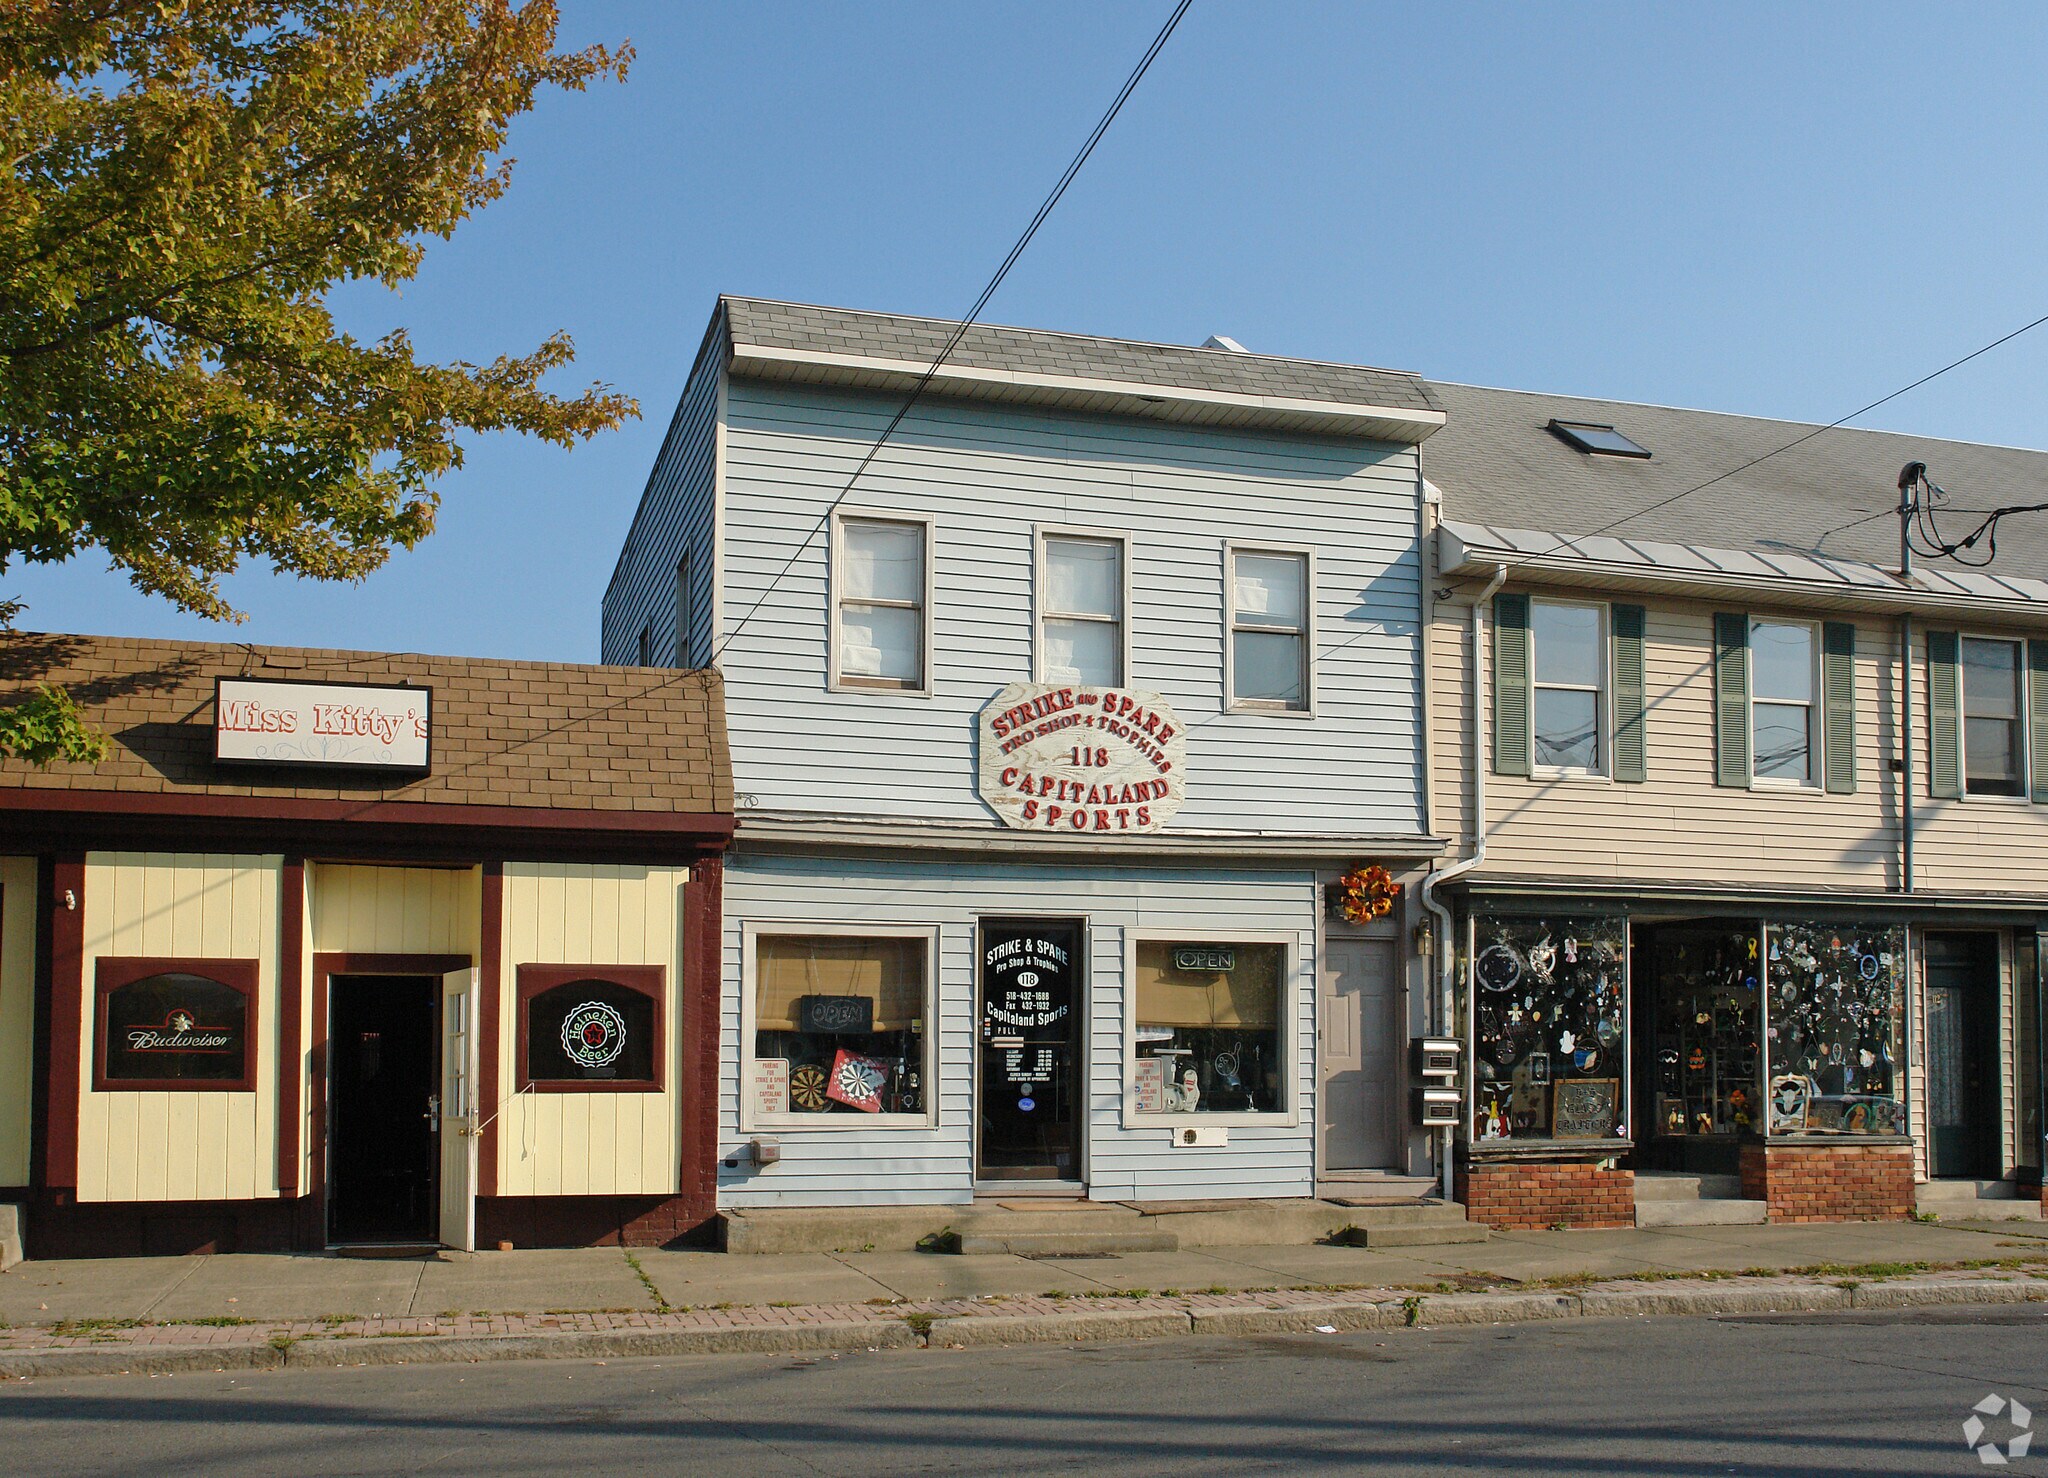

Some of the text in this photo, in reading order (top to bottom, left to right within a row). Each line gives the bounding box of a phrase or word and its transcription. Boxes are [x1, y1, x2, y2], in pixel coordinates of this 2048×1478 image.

[218, 700, 428, 745] Miss Kitty's
[993, 688, 1074, 738] STRIKE
[1103, 693, 1175, 745] SPARE
[1001, 730, 1035, 754] PRO
[1038, 713, 1081, 736] SHOP
[1100, 716, 1172, 773] TROPHIES
[1072, 747, 1109, 767] 118
[1002, 767, 1170, 804] CAPITALAND
[1024, 800, 1151, 830] SPORTS
[987, 938, 1068, 966] STRIKE & SPARE
[1180, 952, 1232, 967] OPEN
[996, 956, 1059, 974] Pro Shop & Trophies
[1021, 974, 1035, 985] 118
[812, 1003, 862, 1024] OPEN
[987, 1001, 1068, 1026] Capitaland Sports
[1005, 1001, 1050, 1010] Fax 432-1932
[569, 1011, 617, 1040] Heineken
[128, 1031, 227, 1050] Budweiser
[577, 1045, 609, 1060] Beer
